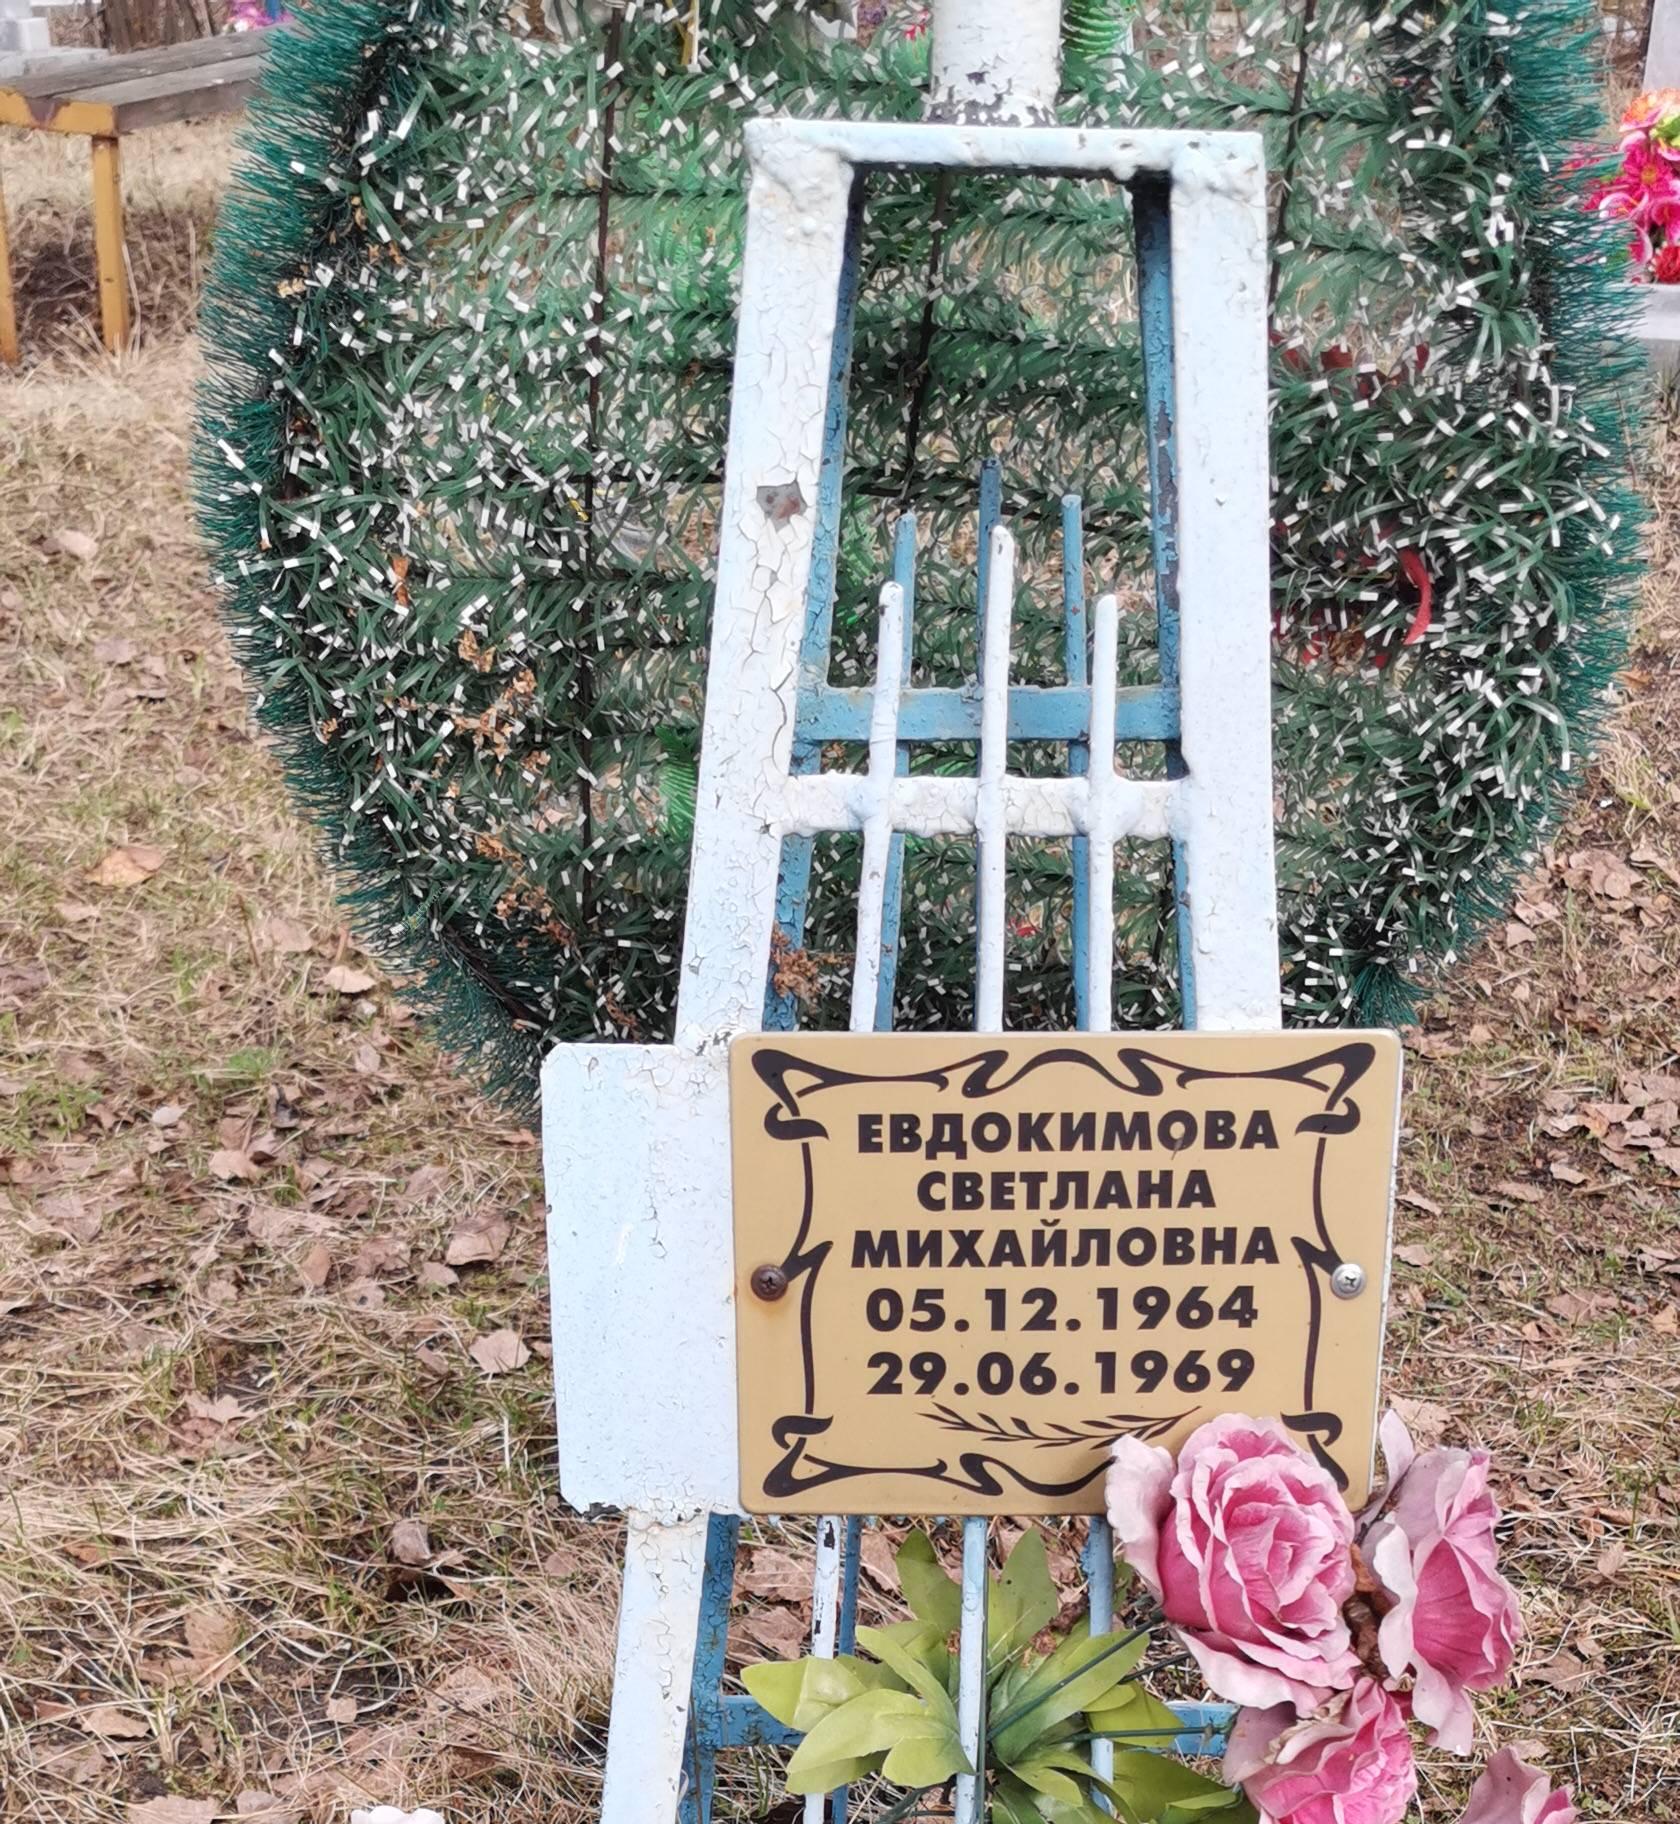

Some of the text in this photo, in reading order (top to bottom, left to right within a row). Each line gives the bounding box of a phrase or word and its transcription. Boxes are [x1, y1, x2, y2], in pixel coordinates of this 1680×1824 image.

[856, 1108, 1280, 1161] ЕВДОКИМОВА
[915, 1168, 1217, 1212] СВЕТЛАНА
[850, 1217, 1281, 1269] МИХАЙЛОВНА
[865, 1284, 1259, 1333] 05.12.1964
[866, 1348, 1256, 1396] 29.06.1969
